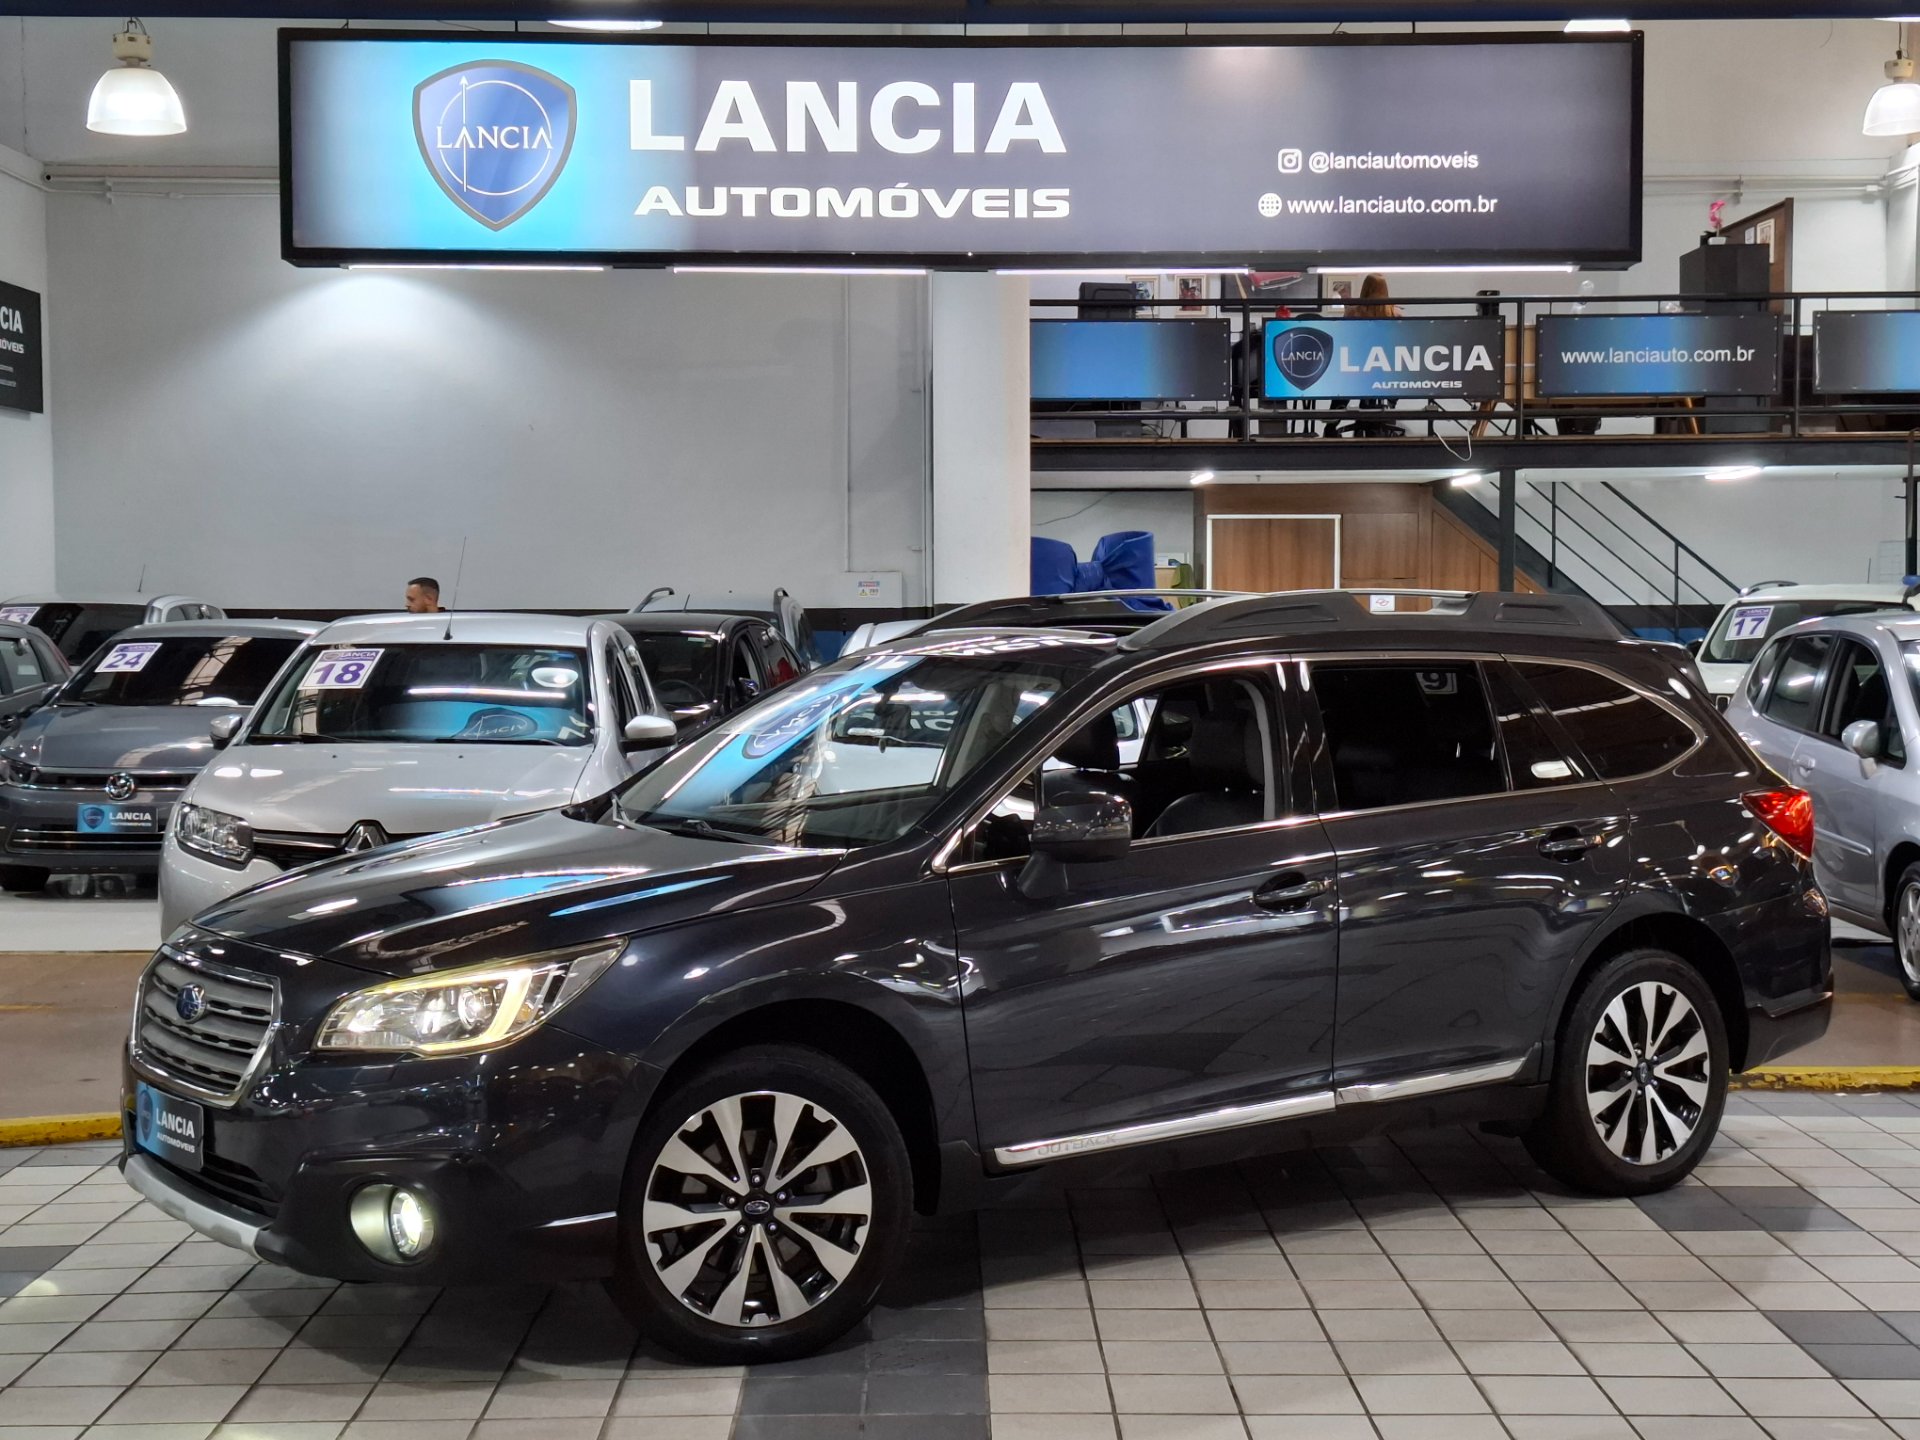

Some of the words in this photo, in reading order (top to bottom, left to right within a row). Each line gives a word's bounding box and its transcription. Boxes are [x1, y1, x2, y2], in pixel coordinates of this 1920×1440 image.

[629, 79, 1067, 154] LANCIA
[436, 125, 554, 149] LANCIA
[1308, 151, 1479, 173] @lanciautomoveis
[634, 182, 1070, 218] AUTOMÓVEIS
[1287, 195, 1498, 213] www.lanciauto.com.br
[1281, 351, 1324, 361] LANCIA
[1340, 345, 1494, 372] LANCIA
[1561, 345, 1755, 363] www.lanciauto.com.br
[1734, 617, 1766, 636] 17
[103, 653, 145, 669] 24
[313, 662, 365, 684] 18
[109, 812, 152, 820] LANCIA
[156, 1108, 195, 1138] LANCIA
[1037, 1134, 1116, 1155] OUTBACK
